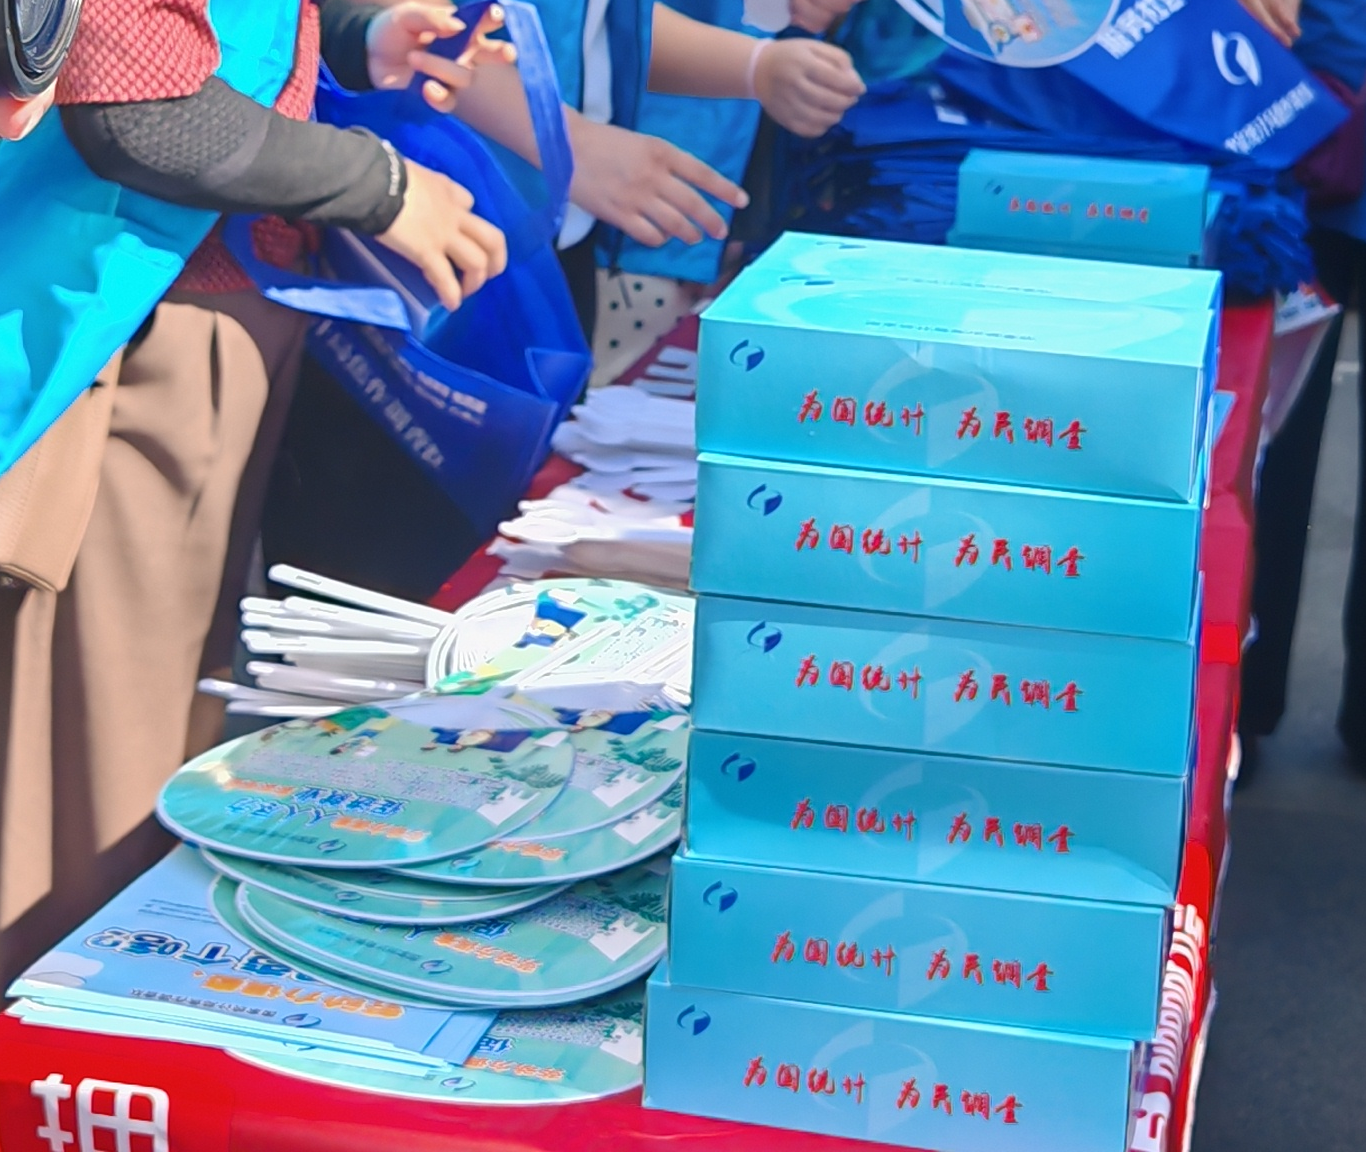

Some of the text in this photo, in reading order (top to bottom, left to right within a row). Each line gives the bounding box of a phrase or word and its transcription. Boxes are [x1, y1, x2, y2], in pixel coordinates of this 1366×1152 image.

[797, 389, 1086, 450] 为国统计 为民调查
[795, 517, 1085, 579] 为国统计 为民调查
[794, 654, 1084, 712] 为国统计 为民调查
[790, 798, 1075, 854] 为国统计 为民调查
[771, 931, 1054, 992] 为国统计 为民调查
[743, 1055, 1023, 1125] 为国统计 为民调查
